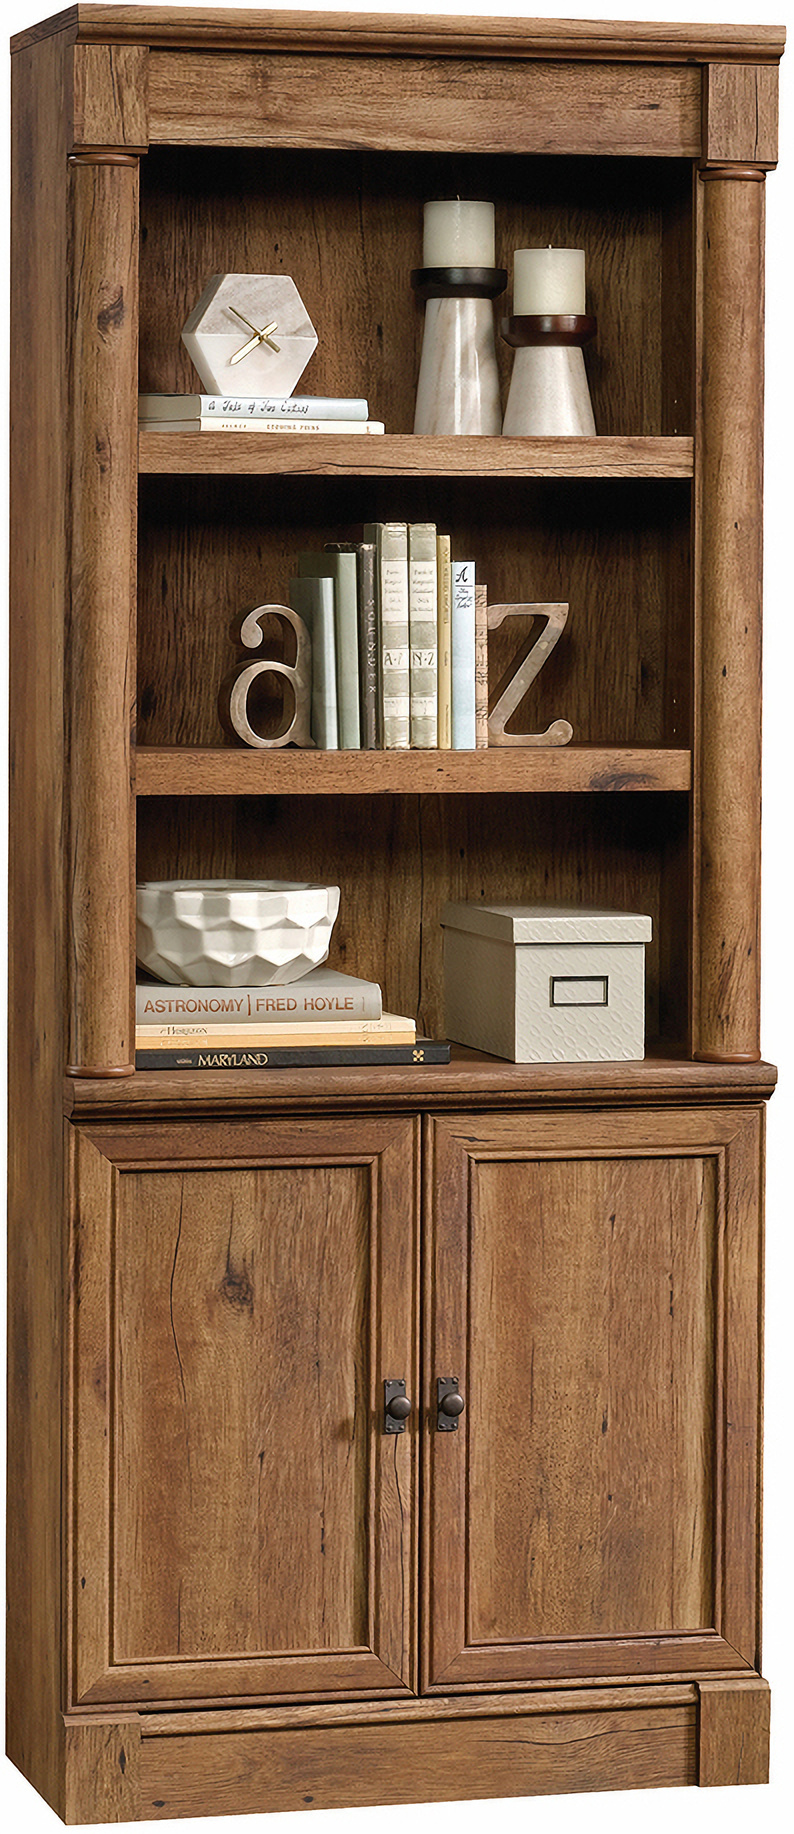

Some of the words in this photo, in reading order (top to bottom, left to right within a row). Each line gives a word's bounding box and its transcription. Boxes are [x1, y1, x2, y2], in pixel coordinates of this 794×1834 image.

[230, 604, 316, 749] a
[144, 999, 244, 1013] ASTRONOMY
[256, 998, 298, 1012] FRED
[304, 997, 354, 1011] HOYLE
[198, 1053, 269, 1067] MARYLAND
